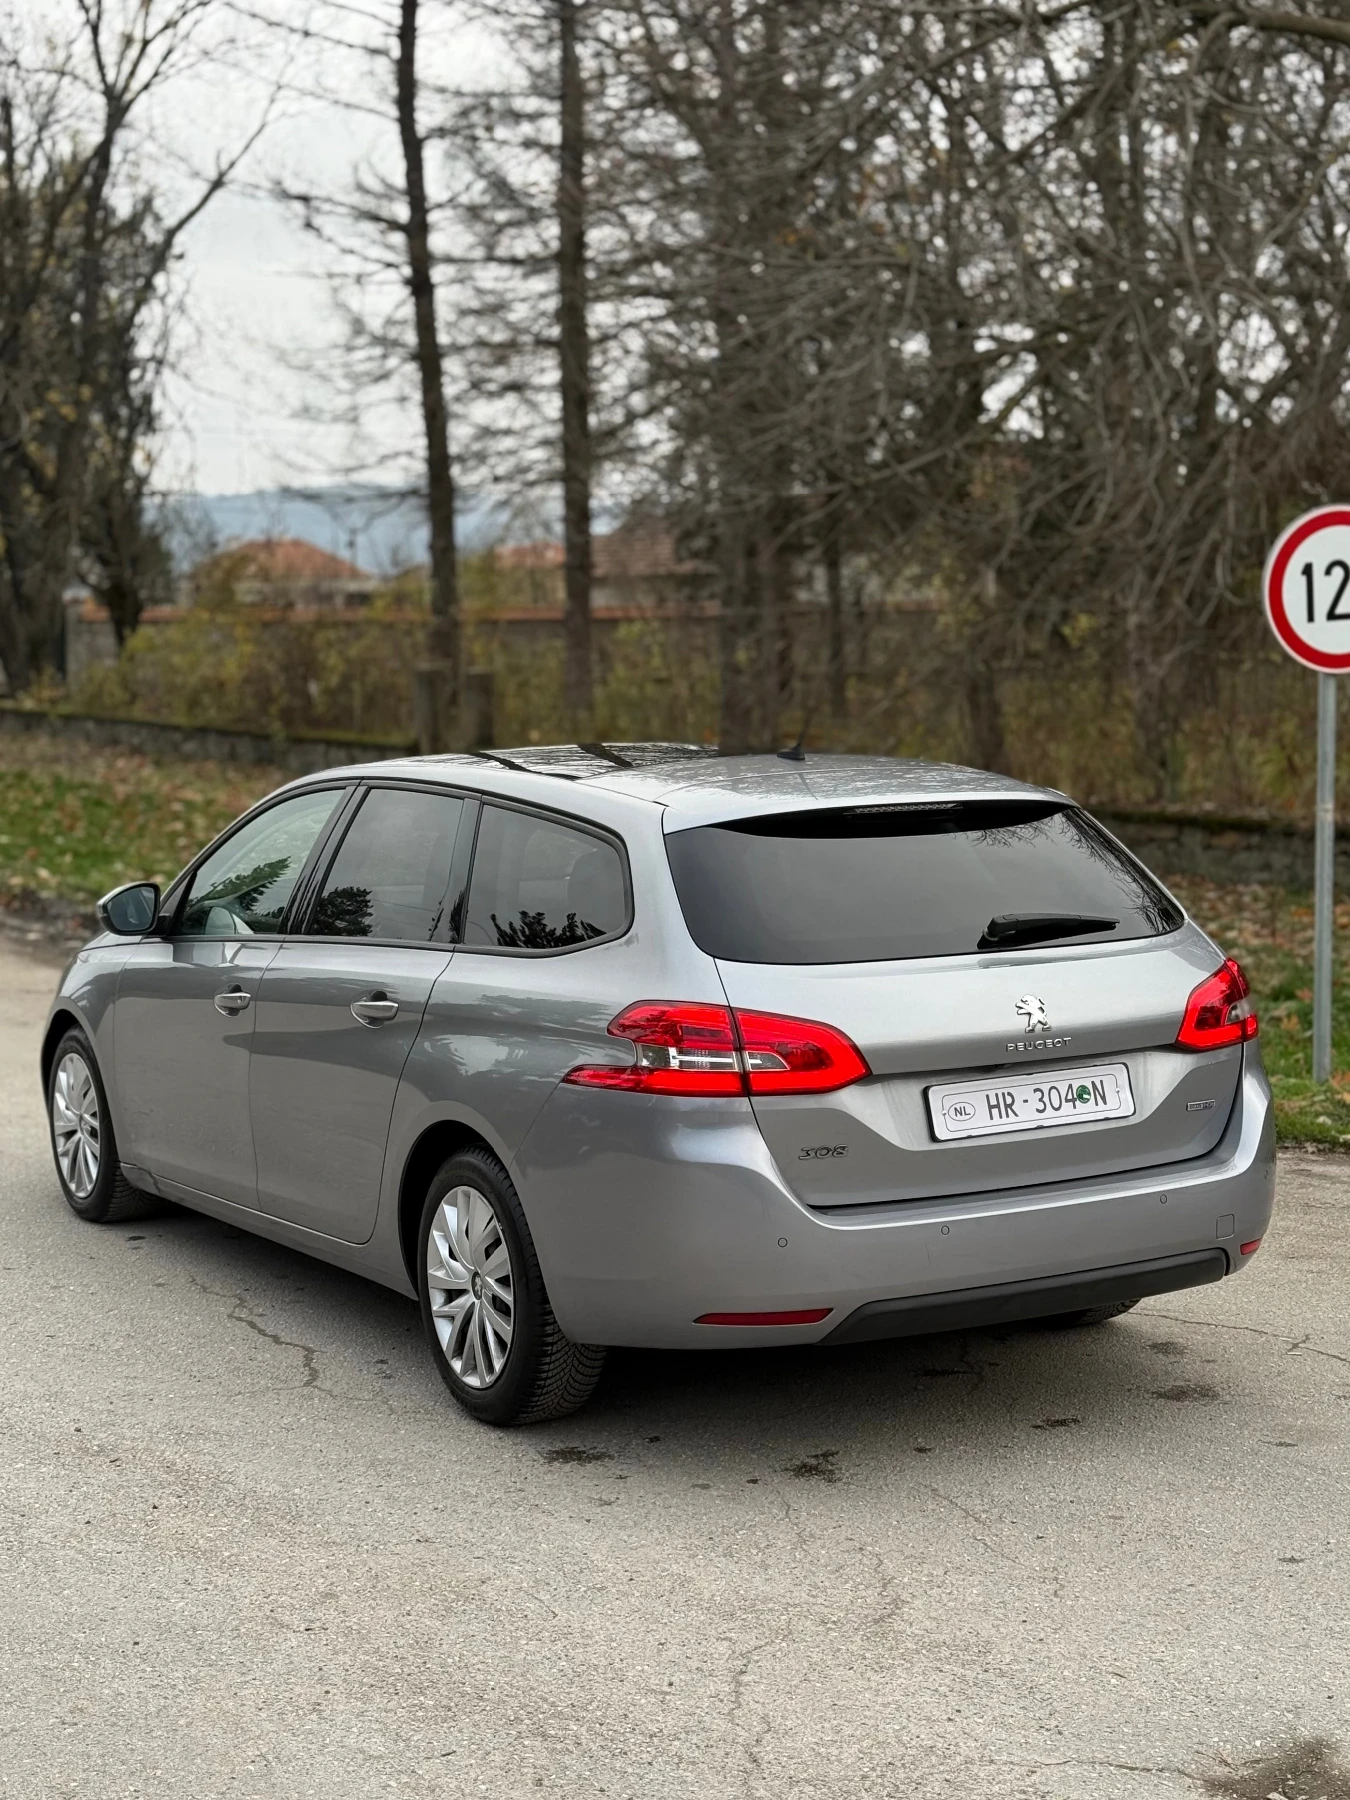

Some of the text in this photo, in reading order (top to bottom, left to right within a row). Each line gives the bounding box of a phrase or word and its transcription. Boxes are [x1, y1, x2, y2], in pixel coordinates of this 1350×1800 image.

[1301, 559, 1350, 623] 12
[1006, 1037, 1071, 1052] PEUGEOT
[954, 1106, 971, 1117] NL
[798, 1144, 848, 1160] 308
